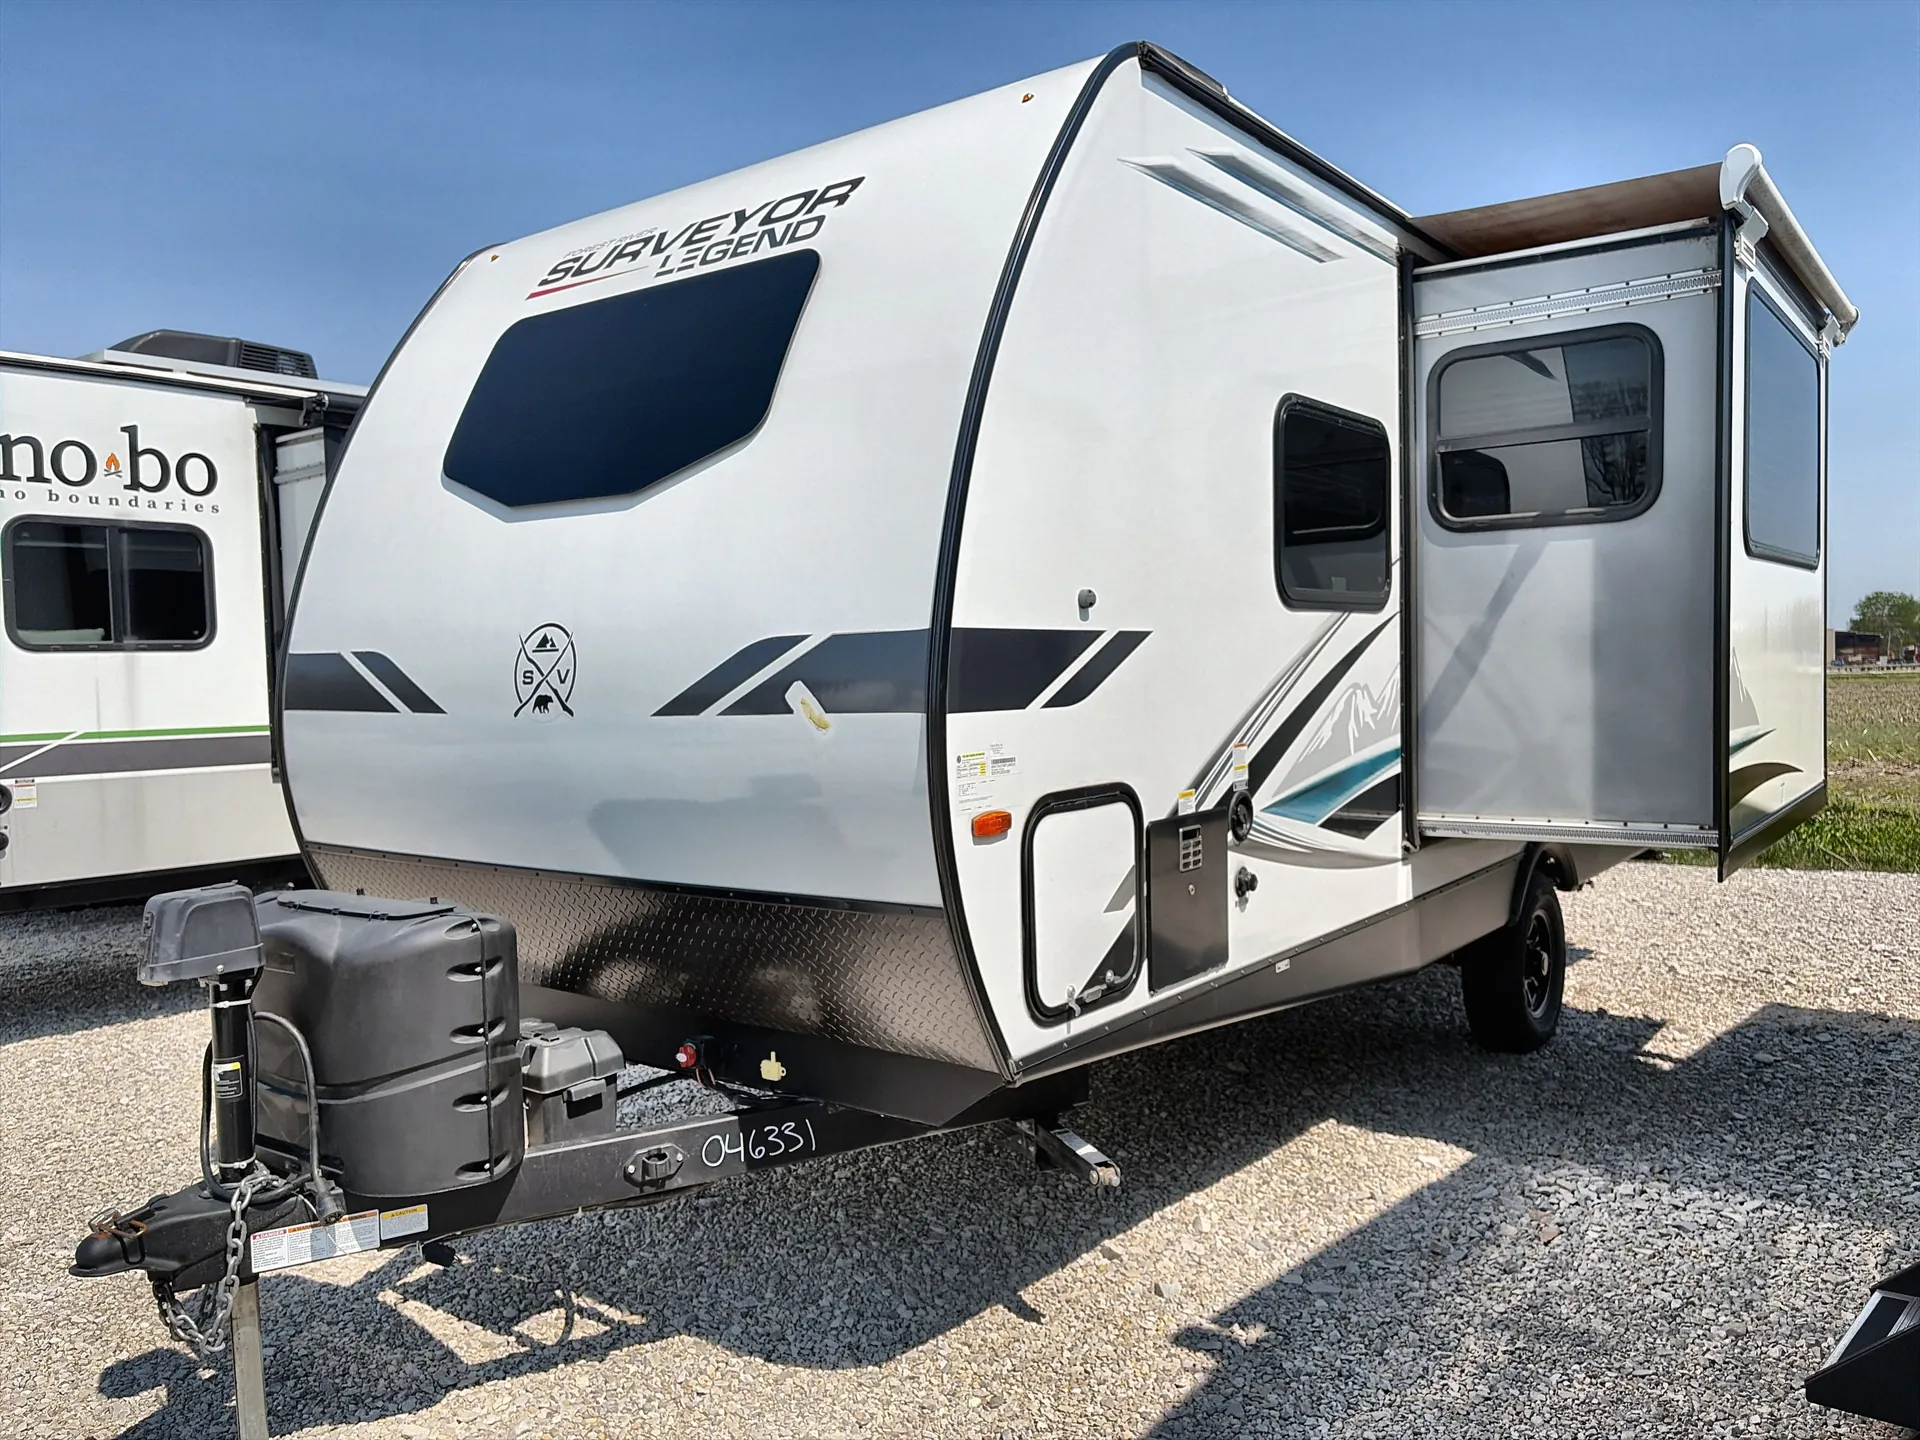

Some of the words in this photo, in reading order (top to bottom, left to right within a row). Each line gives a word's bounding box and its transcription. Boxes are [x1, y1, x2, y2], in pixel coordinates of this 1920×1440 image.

[538, 176, 866, 287] SURVEYOR
[615, 227, 658, 245] RIVER
[654, 214, 826, 278] LEGEND
[47, 489, 220, 514] boundaries
[522, 669, 534, 685] S
[557, 669, 570, 684] V
[701, 1118, 816, 1167] 046331
[395, 1207, 418, 1217] CAUTION
